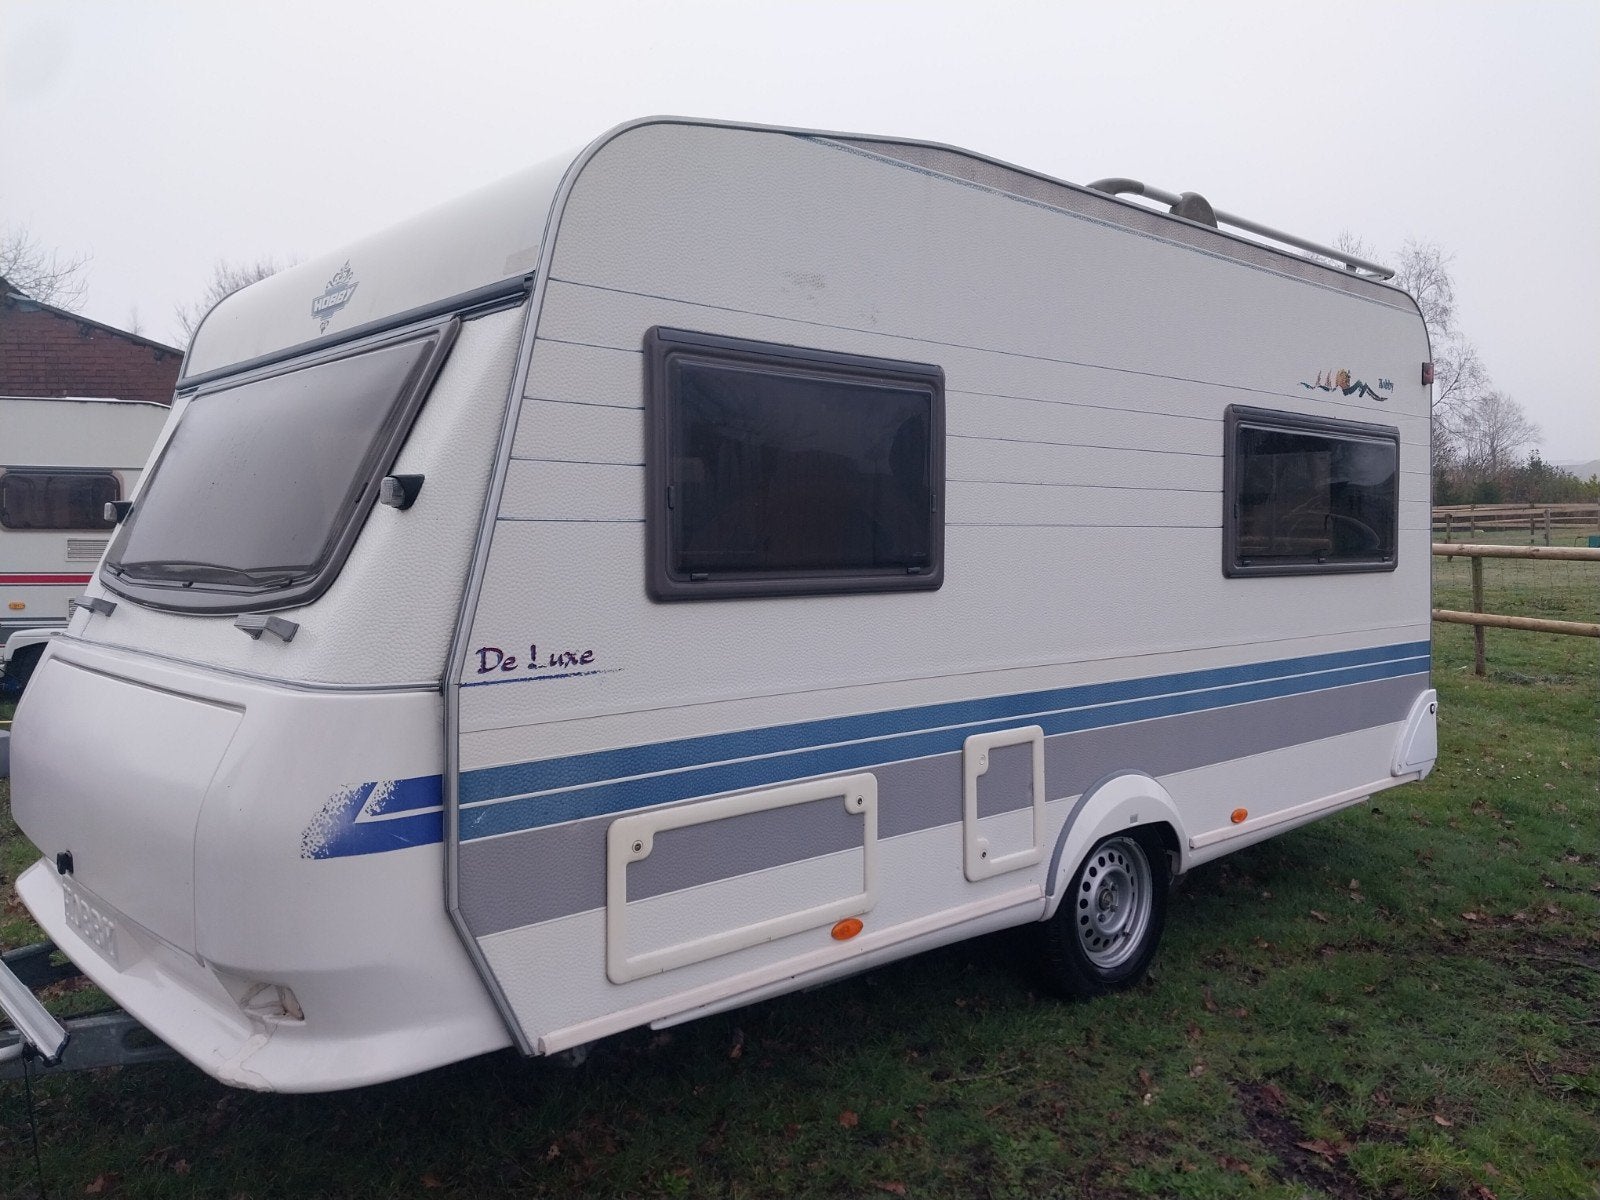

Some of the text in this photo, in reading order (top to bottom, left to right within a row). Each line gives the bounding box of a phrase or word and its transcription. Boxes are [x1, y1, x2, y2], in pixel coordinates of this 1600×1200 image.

[312, 284, 357, 315] HOBBY
[475, 643, 596, 675] De Luxe
